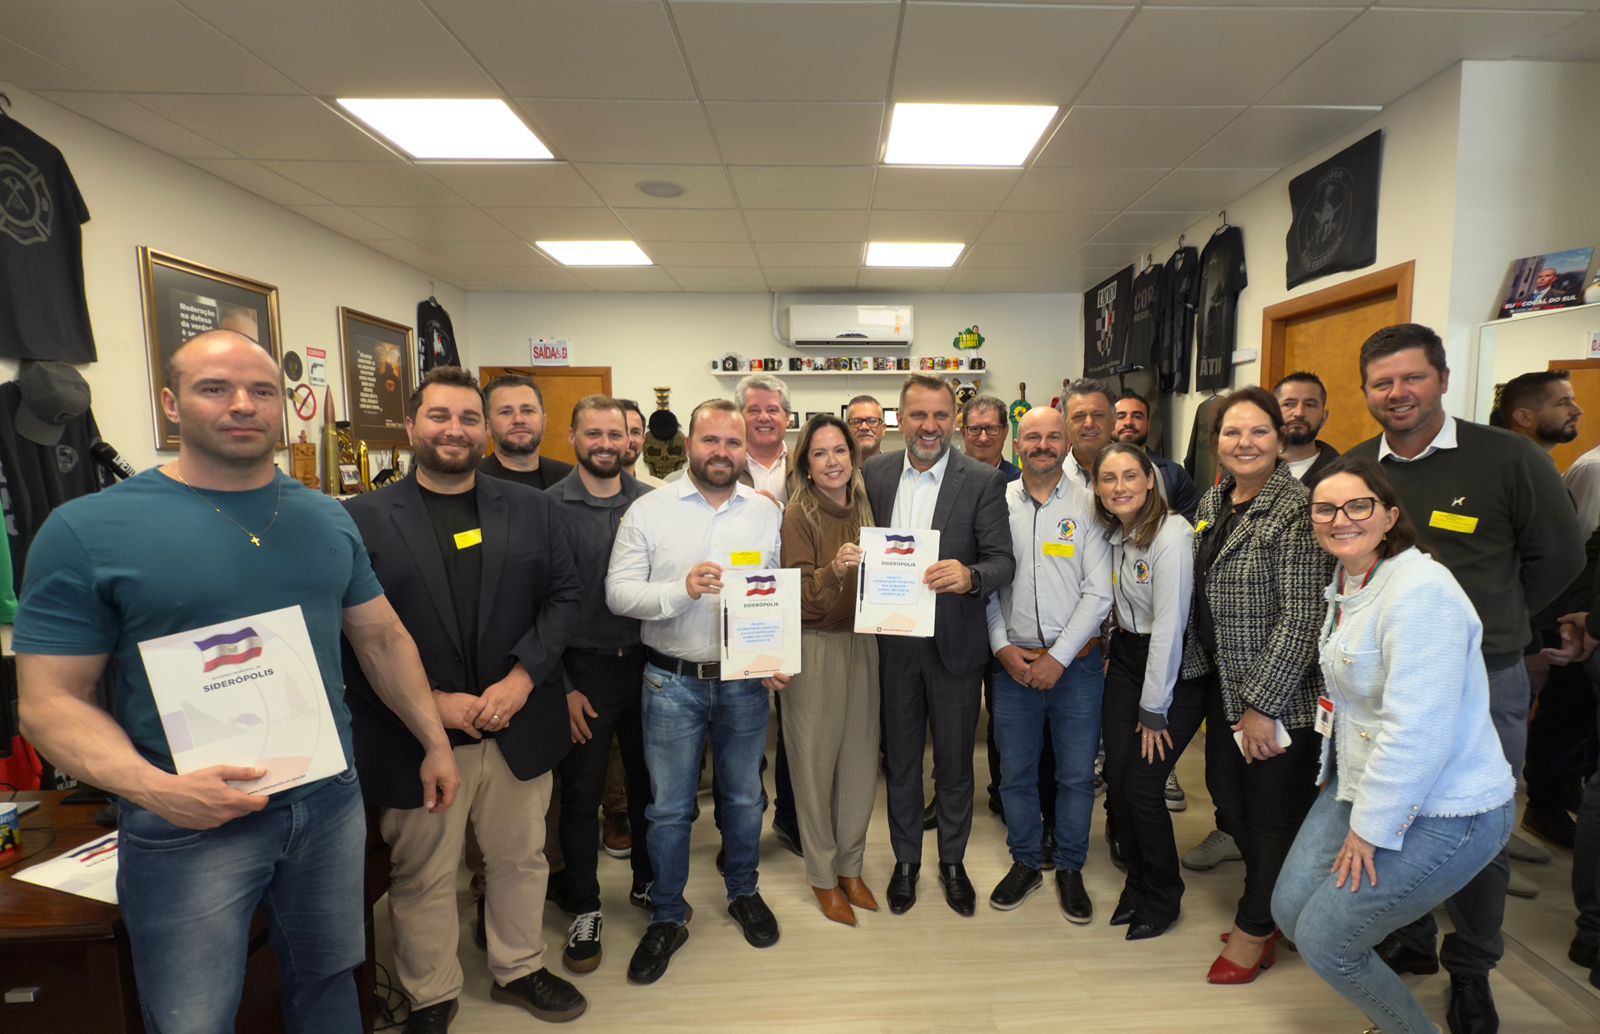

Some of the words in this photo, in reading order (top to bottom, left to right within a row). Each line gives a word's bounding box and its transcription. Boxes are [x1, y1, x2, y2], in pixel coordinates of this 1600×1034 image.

[179, 302, 216, 318] Moderação
[180, 312, 189, 320] na
[190, 314, 212, 325] defesa
[181, 320, 190, 329] da
[881, 560, 917, 568] SIDERÓPOLIS
[743, 601, 779, 609] SIDERÓPOLIS
[202, 667, 275, 693] SIDERÓPOLIS
